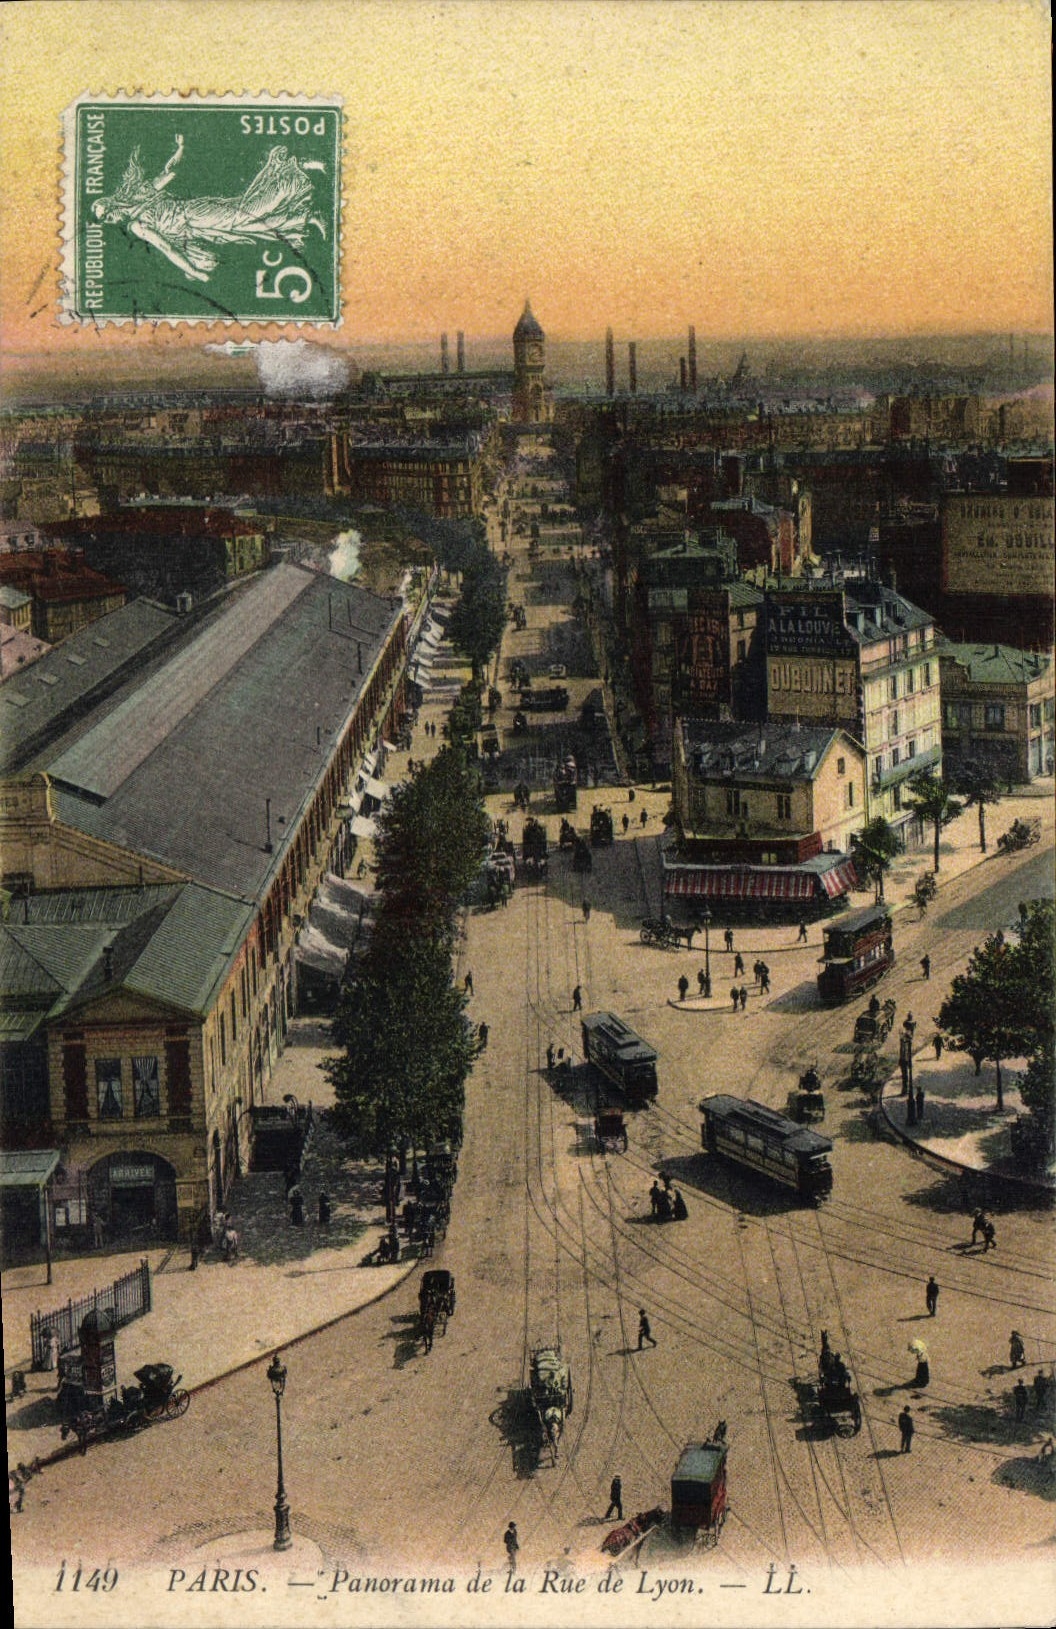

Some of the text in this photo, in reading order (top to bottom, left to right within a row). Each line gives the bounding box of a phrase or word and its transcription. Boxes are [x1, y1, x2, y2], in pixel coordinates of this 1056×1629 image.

[241, 115, 325, 135] POSTES
[85, 221, 105, 309] REPUBLIQUE
[779, 606, 828, 618] FIL
[771, 663, 856, 694] DUBONNET
